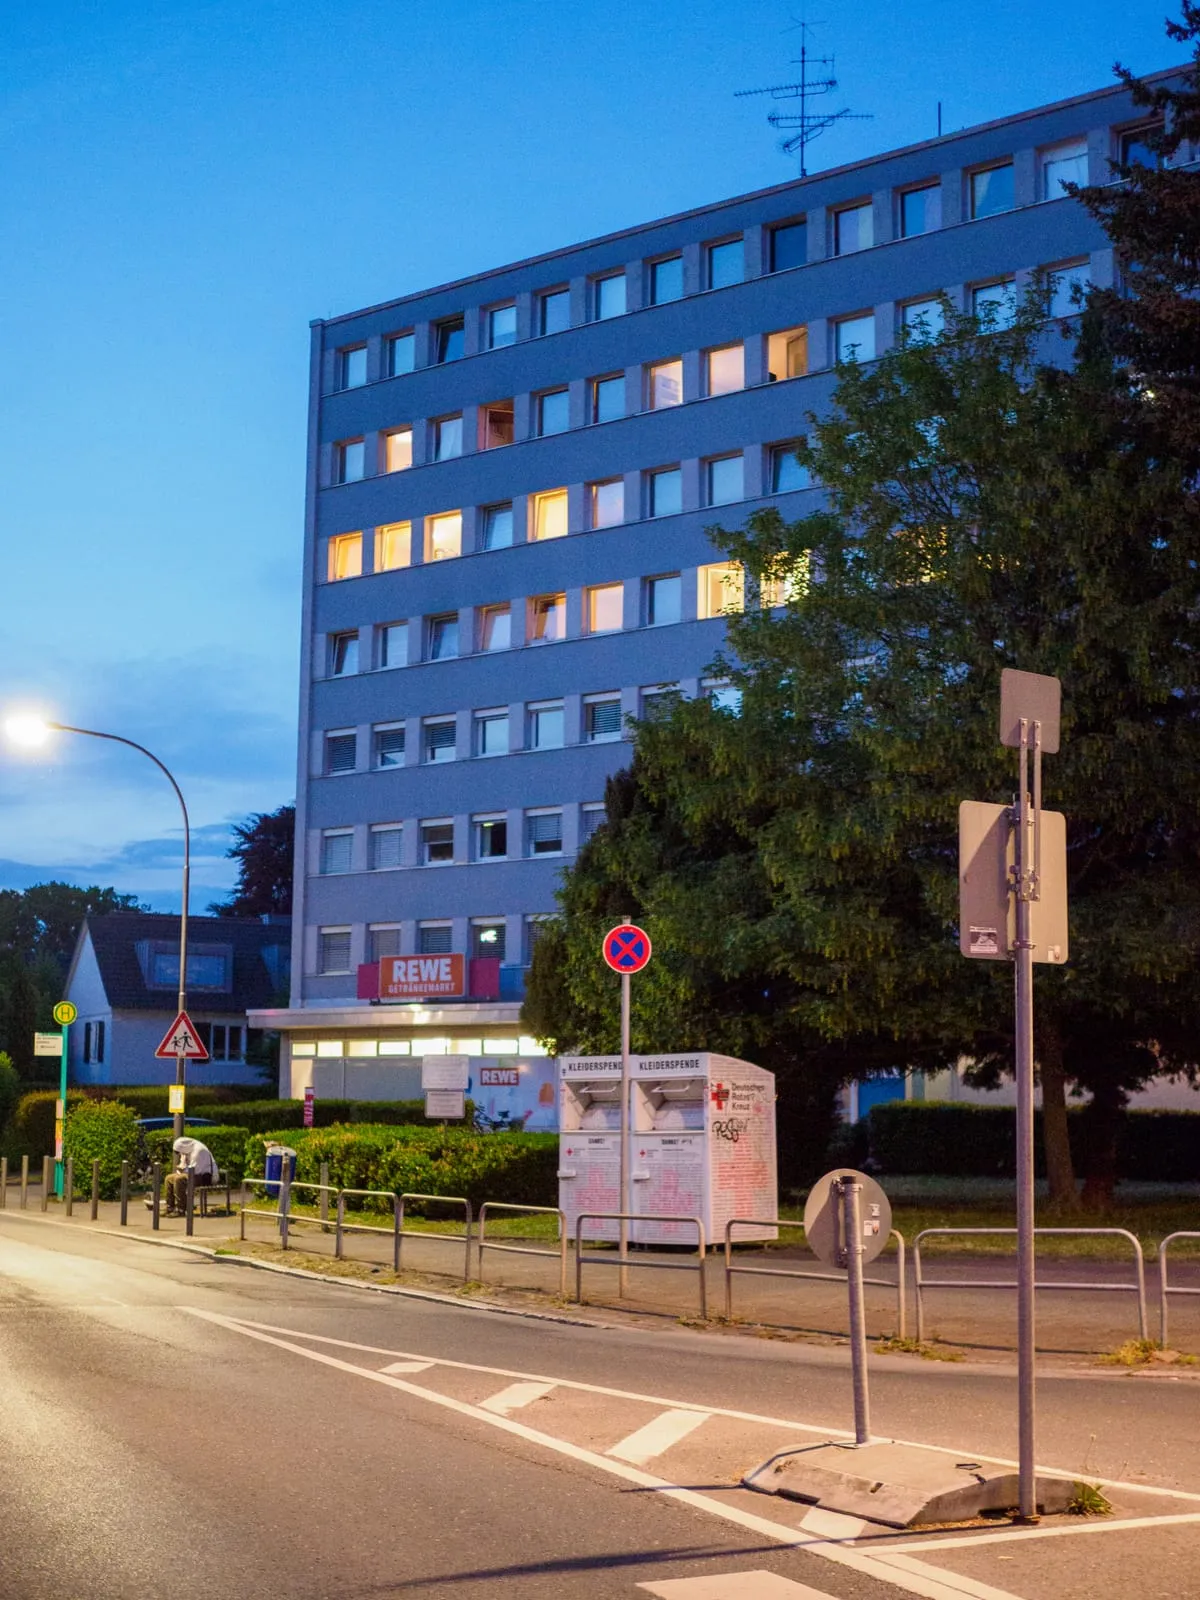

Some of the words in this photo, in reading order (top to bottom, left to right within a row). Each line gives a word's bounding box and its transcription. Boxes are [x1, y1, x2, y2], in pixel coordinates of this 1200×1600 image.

[393, 958, 452, 982] REWE
[388, 982, 456, 994] GETRÄNKEMARKT
[61, 1007, 70, 1019] H
[568, 1060, 624, 1072] KLEIDERSPEND
[639, 1058, 700, 1071] KLEIDERSPENDE
[483, 1070, 518, 1083] REWE
[731, 1103, 750, 1111] Kreuz
